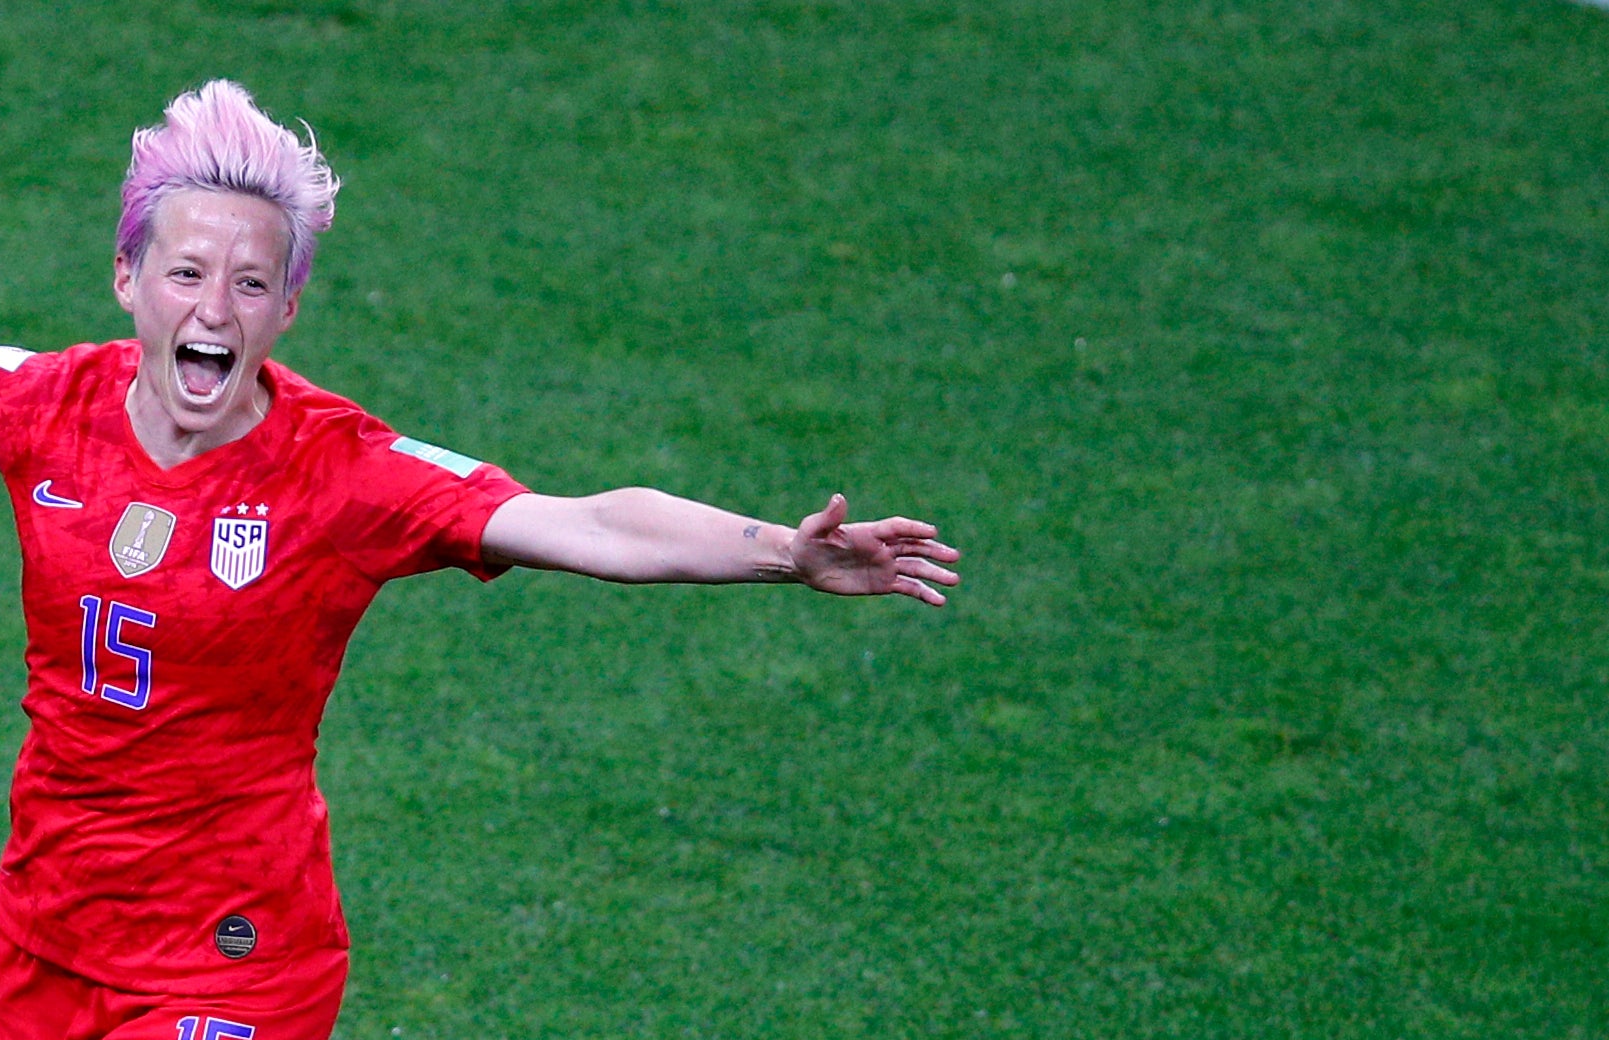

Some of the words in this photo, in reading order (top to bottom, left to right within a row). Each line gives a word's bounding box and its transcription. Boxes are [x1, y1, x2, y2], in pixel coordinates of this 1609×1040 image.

[218, 523, 262, 549] USA
[122, 545, 145, 561] FIFA
[80, 594, 156, 710] 15
